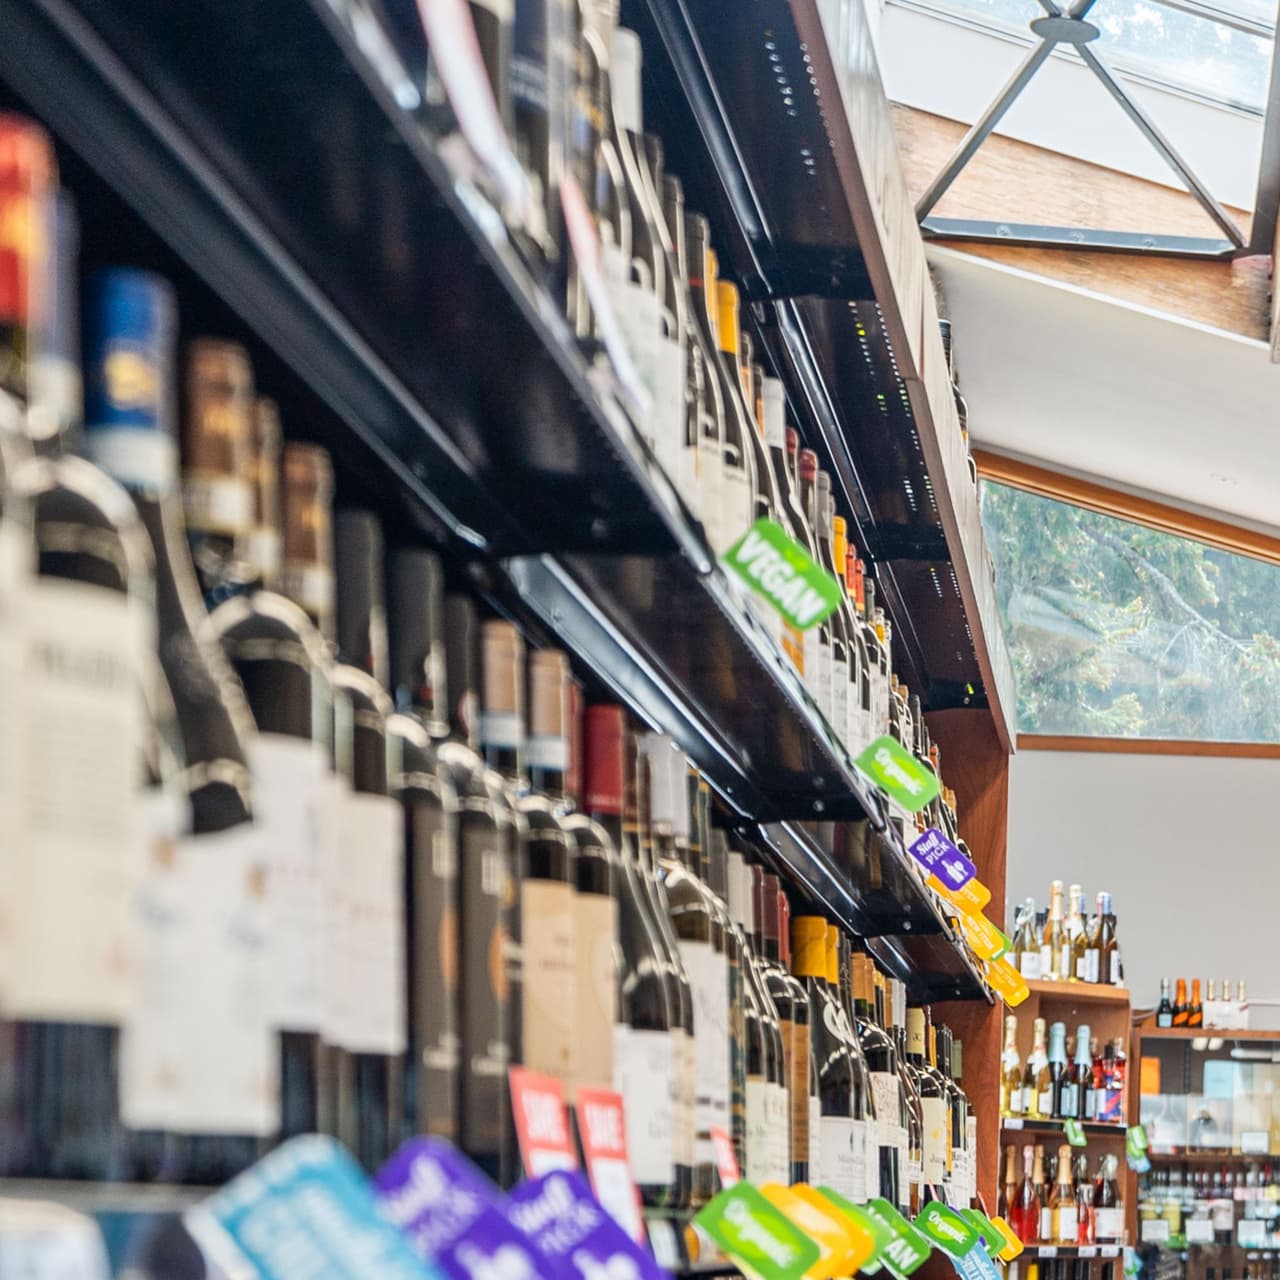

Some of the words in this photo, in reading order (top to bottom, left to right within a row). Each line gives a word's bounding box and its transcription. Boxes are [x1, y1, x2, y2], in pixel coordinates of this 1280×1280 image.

[735, 531, 825, 622] VEGAN
[916, 832, 939, 856] Staff
[926, 840, 951, 866] PICK
[928, 1210, 967, 1244] Organic
